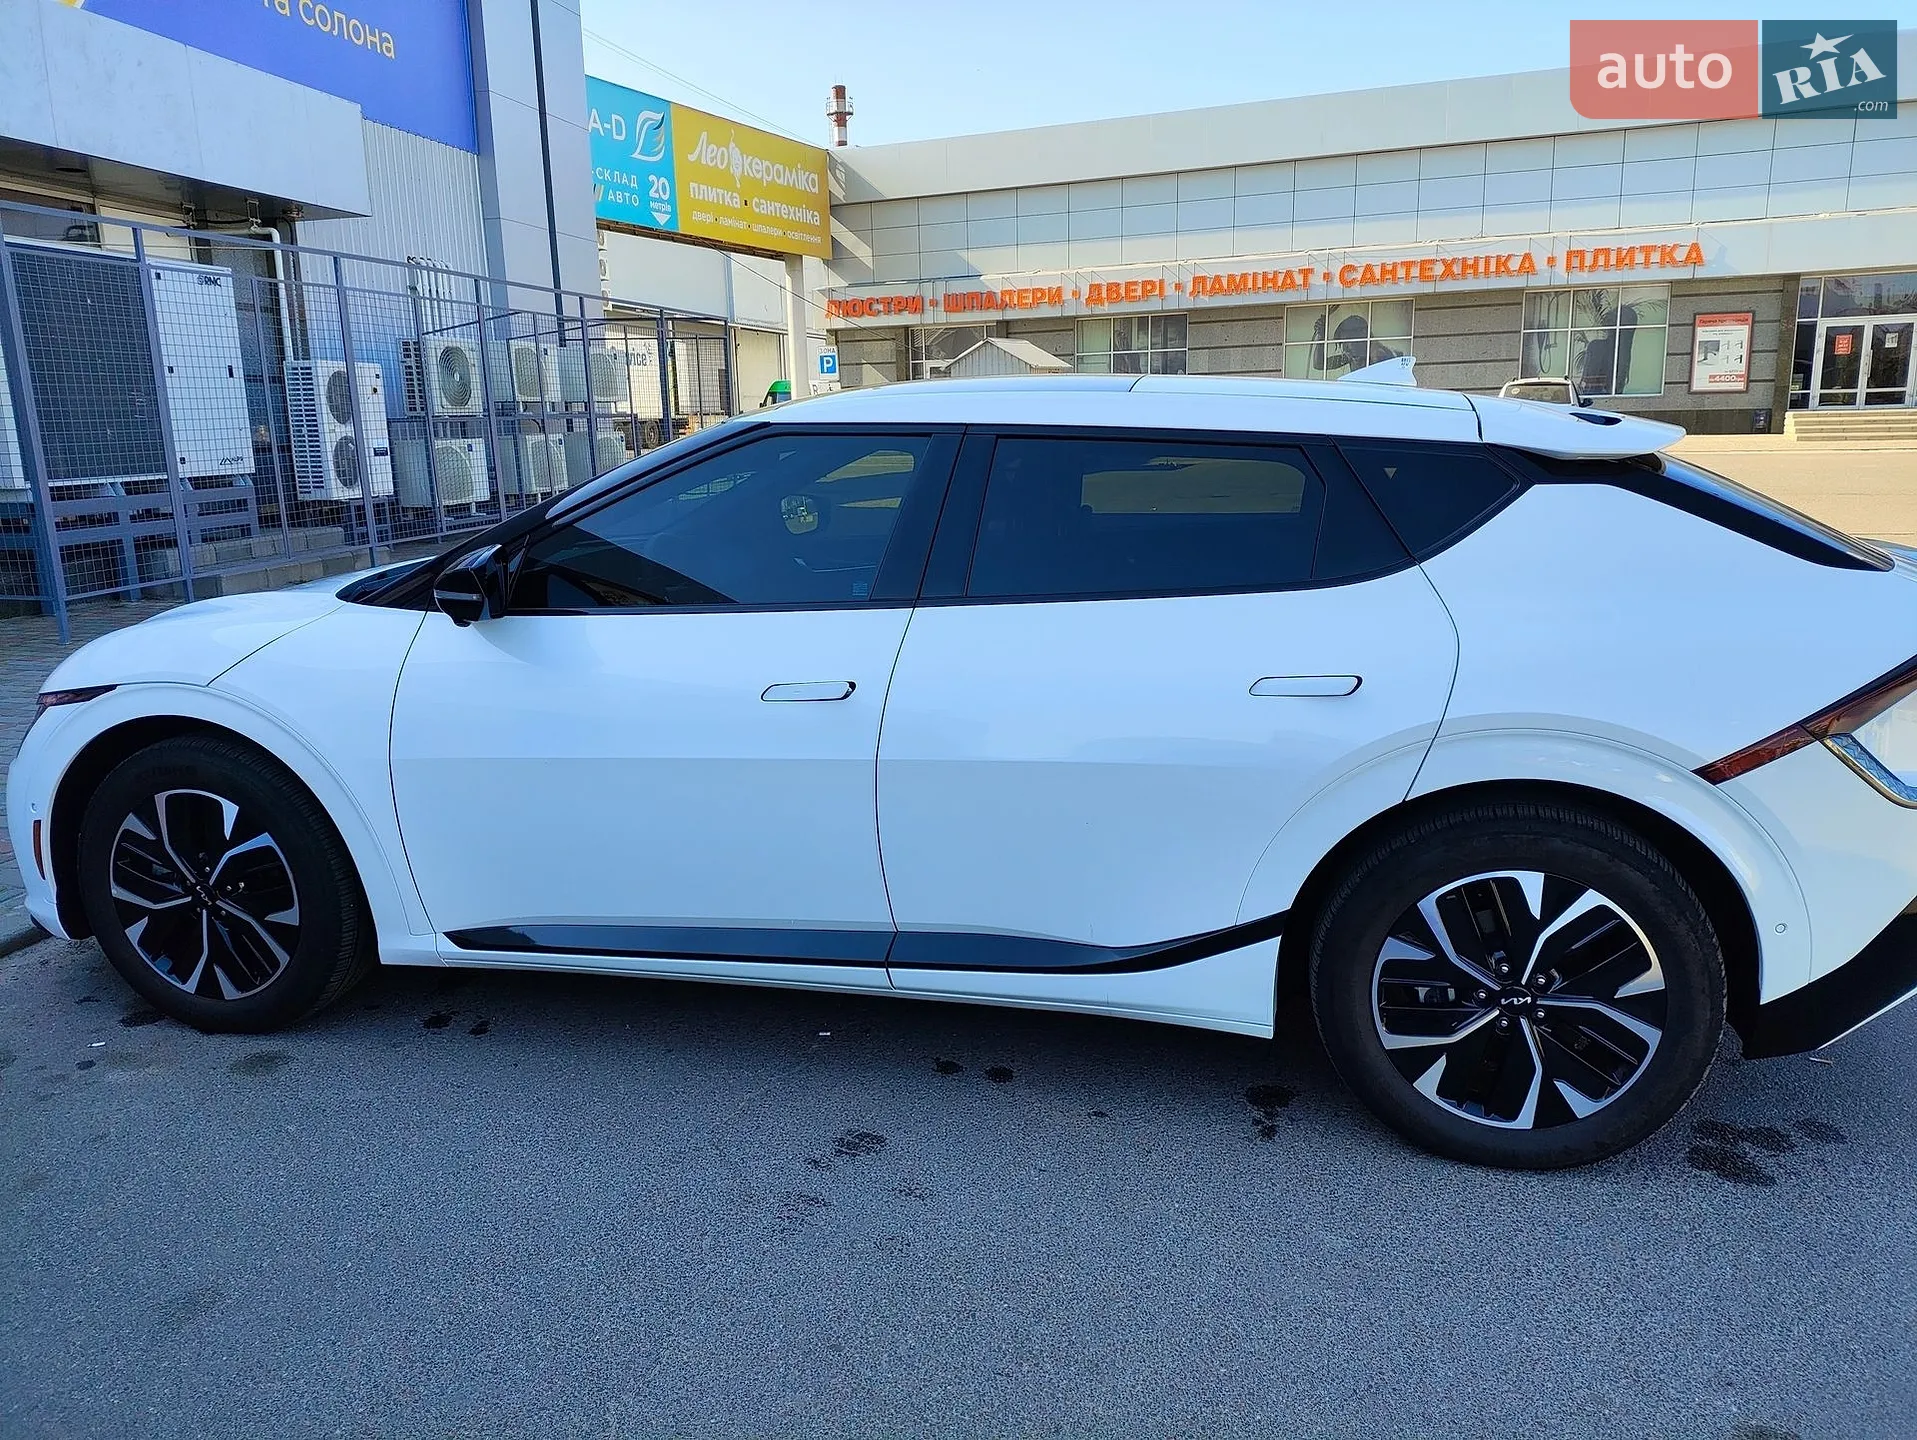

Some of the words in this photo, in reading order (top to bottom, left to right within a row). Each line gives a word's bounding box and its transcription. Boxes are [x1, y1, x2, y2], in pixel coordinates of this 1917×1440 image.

[264, 0, 290, 17] а
[298, 0, 396, 60] солона
[607, 189, 640, 207] АВТО
[648, 174, 671, 201] 20
[689, 181, 741, 209] плитка
[752, 196, 821, 227] сантехніка
[692, 210, 714, 224] двері
[719, 215, 748, 231] ламінат
[752, 223, 784, 238] шпалери
[825, 295, 924, 319] ЛЮСТРИ
[943, 286, 1064, 313] ШПАЛЕРИ
[1085, 278, 1165, 308] ДВЕРІ
[1189, 267, 1315, 298] ЛАМІНАТ
[1338, 252, 1538, 288] САНТЕХНІКА
[1565, 242, 1705, 273] ПЛИТКА
[823, 356, 834, 373] P
